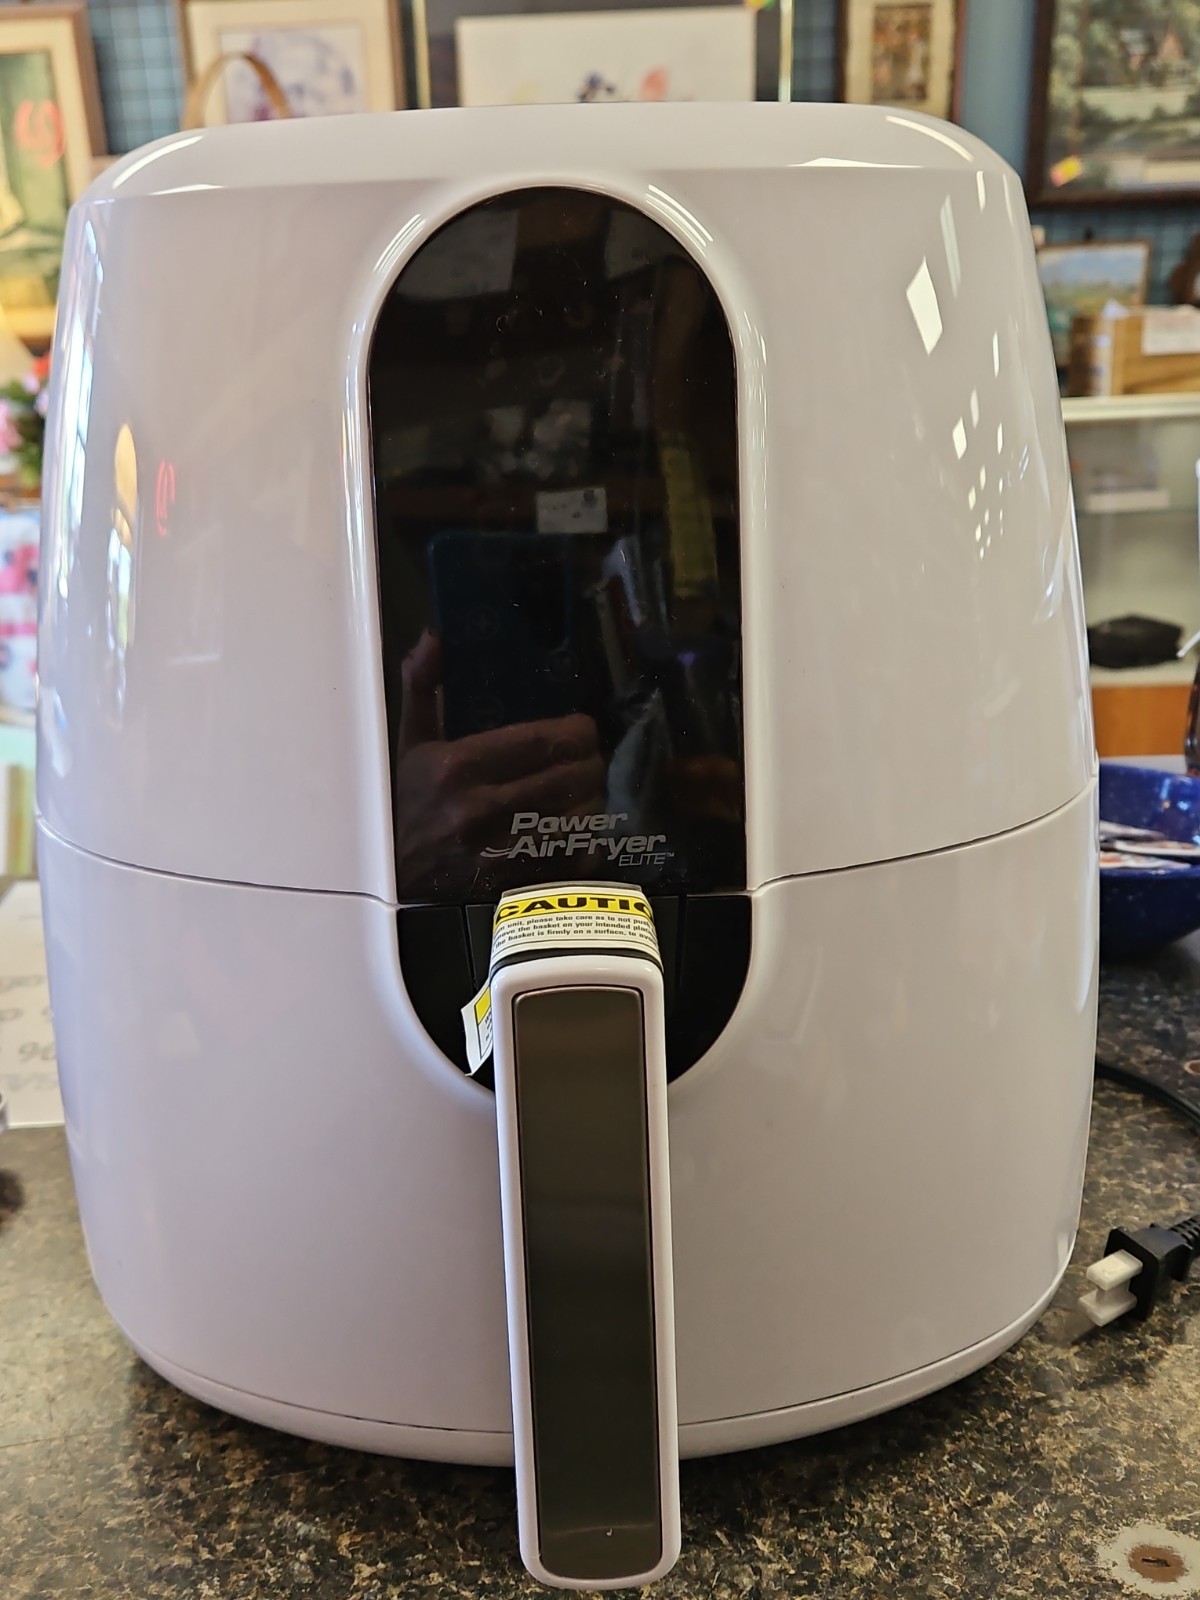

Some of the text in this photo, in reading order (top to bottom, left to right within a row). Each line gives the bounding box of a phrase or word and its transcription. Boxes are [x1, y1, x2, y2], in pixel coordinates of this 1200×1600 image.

[510, 812, 628, 835] Power
[506, 833, 667, 860] AirFryer
[526, 916, 553, 925] please
[533, 922, 560, 930] basket
[595, 921, 631, 930] intended
[508, 931, 535, 941] basket
